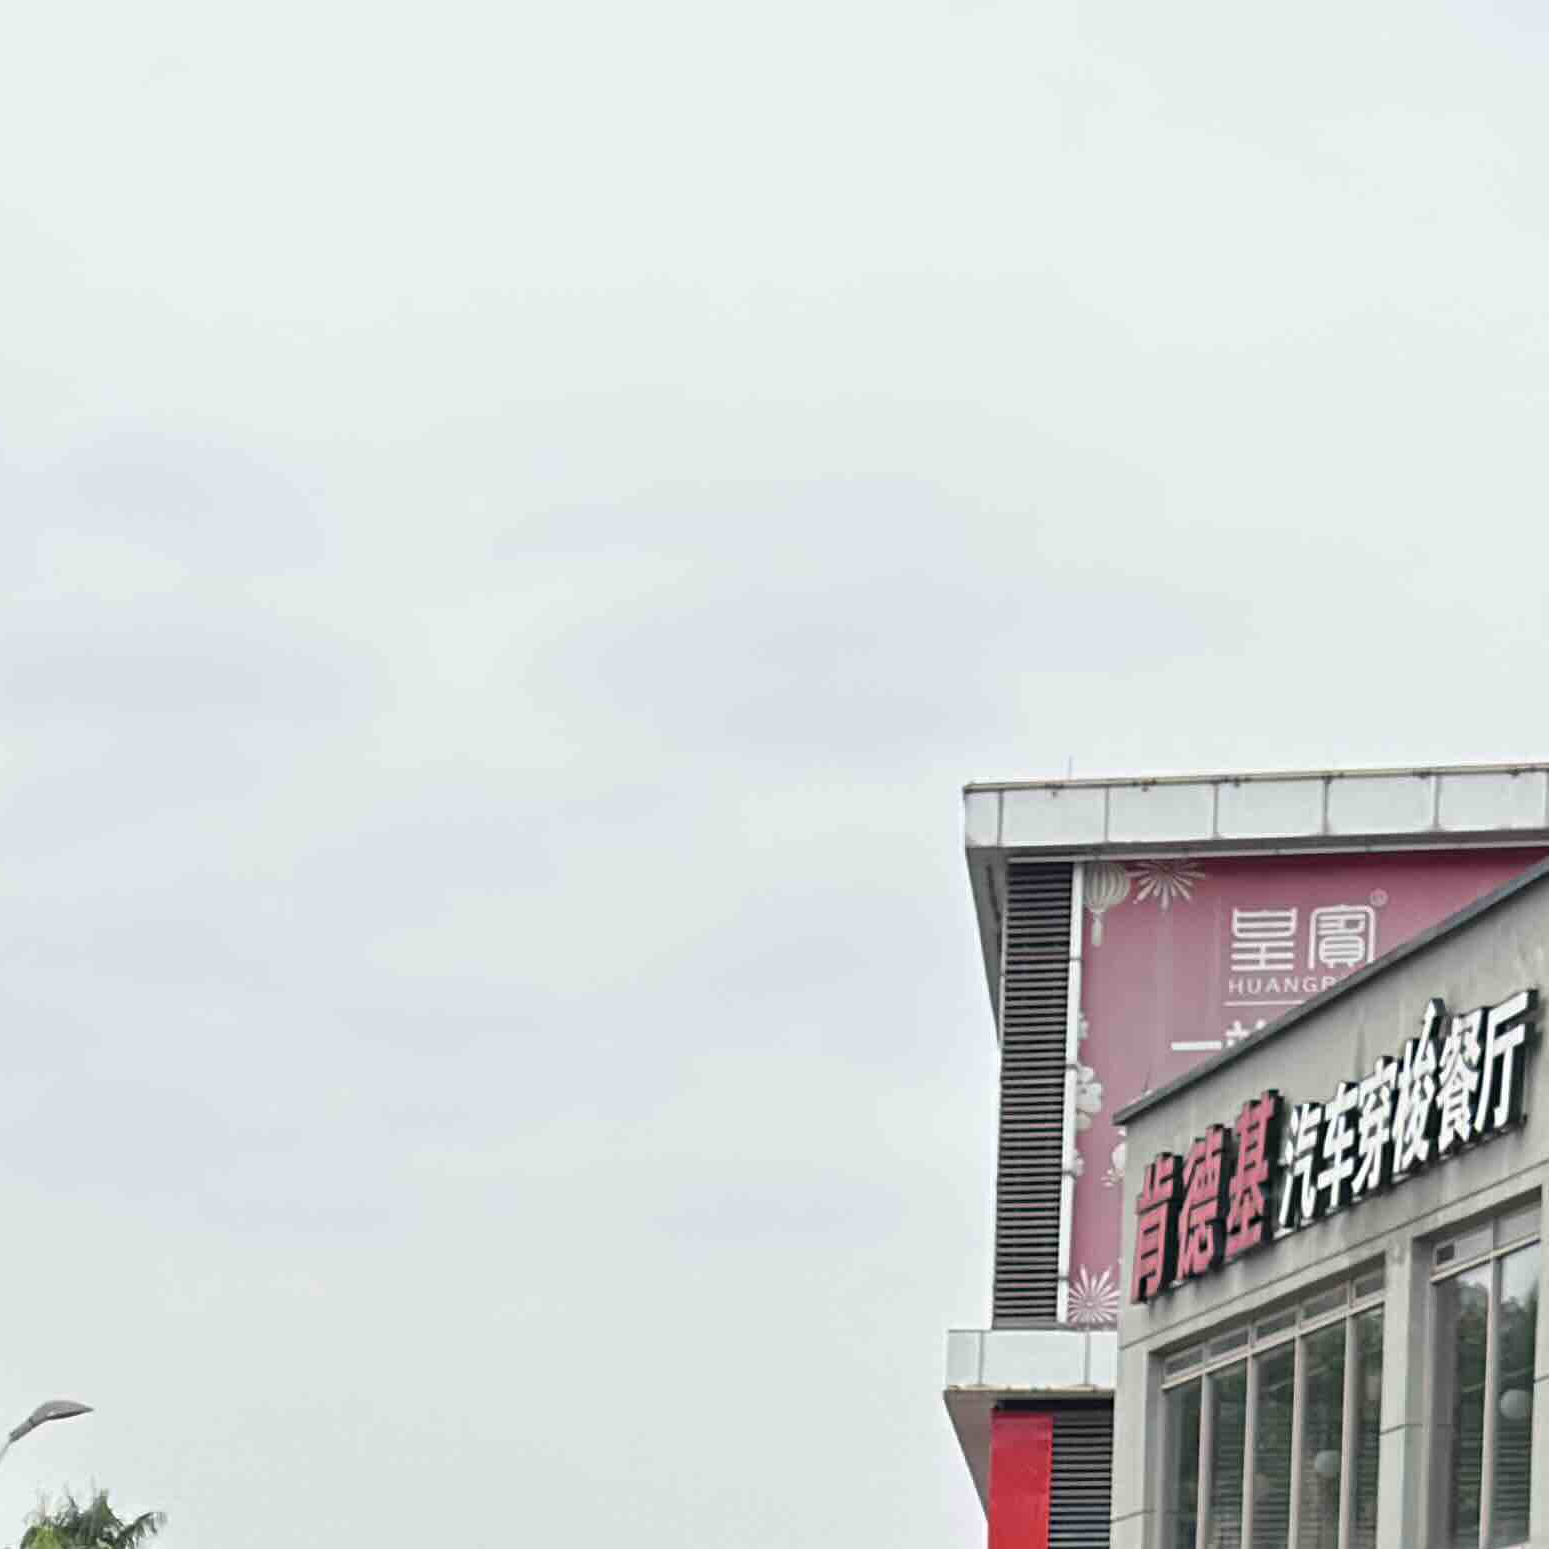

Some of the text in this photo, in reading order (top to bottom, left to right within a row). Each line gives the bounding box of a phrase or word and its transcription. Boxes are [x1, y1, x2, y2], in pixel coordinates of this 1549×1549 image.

[1130, 991, 1530, 1304] 肯德基 汽车穿梭餐厅
